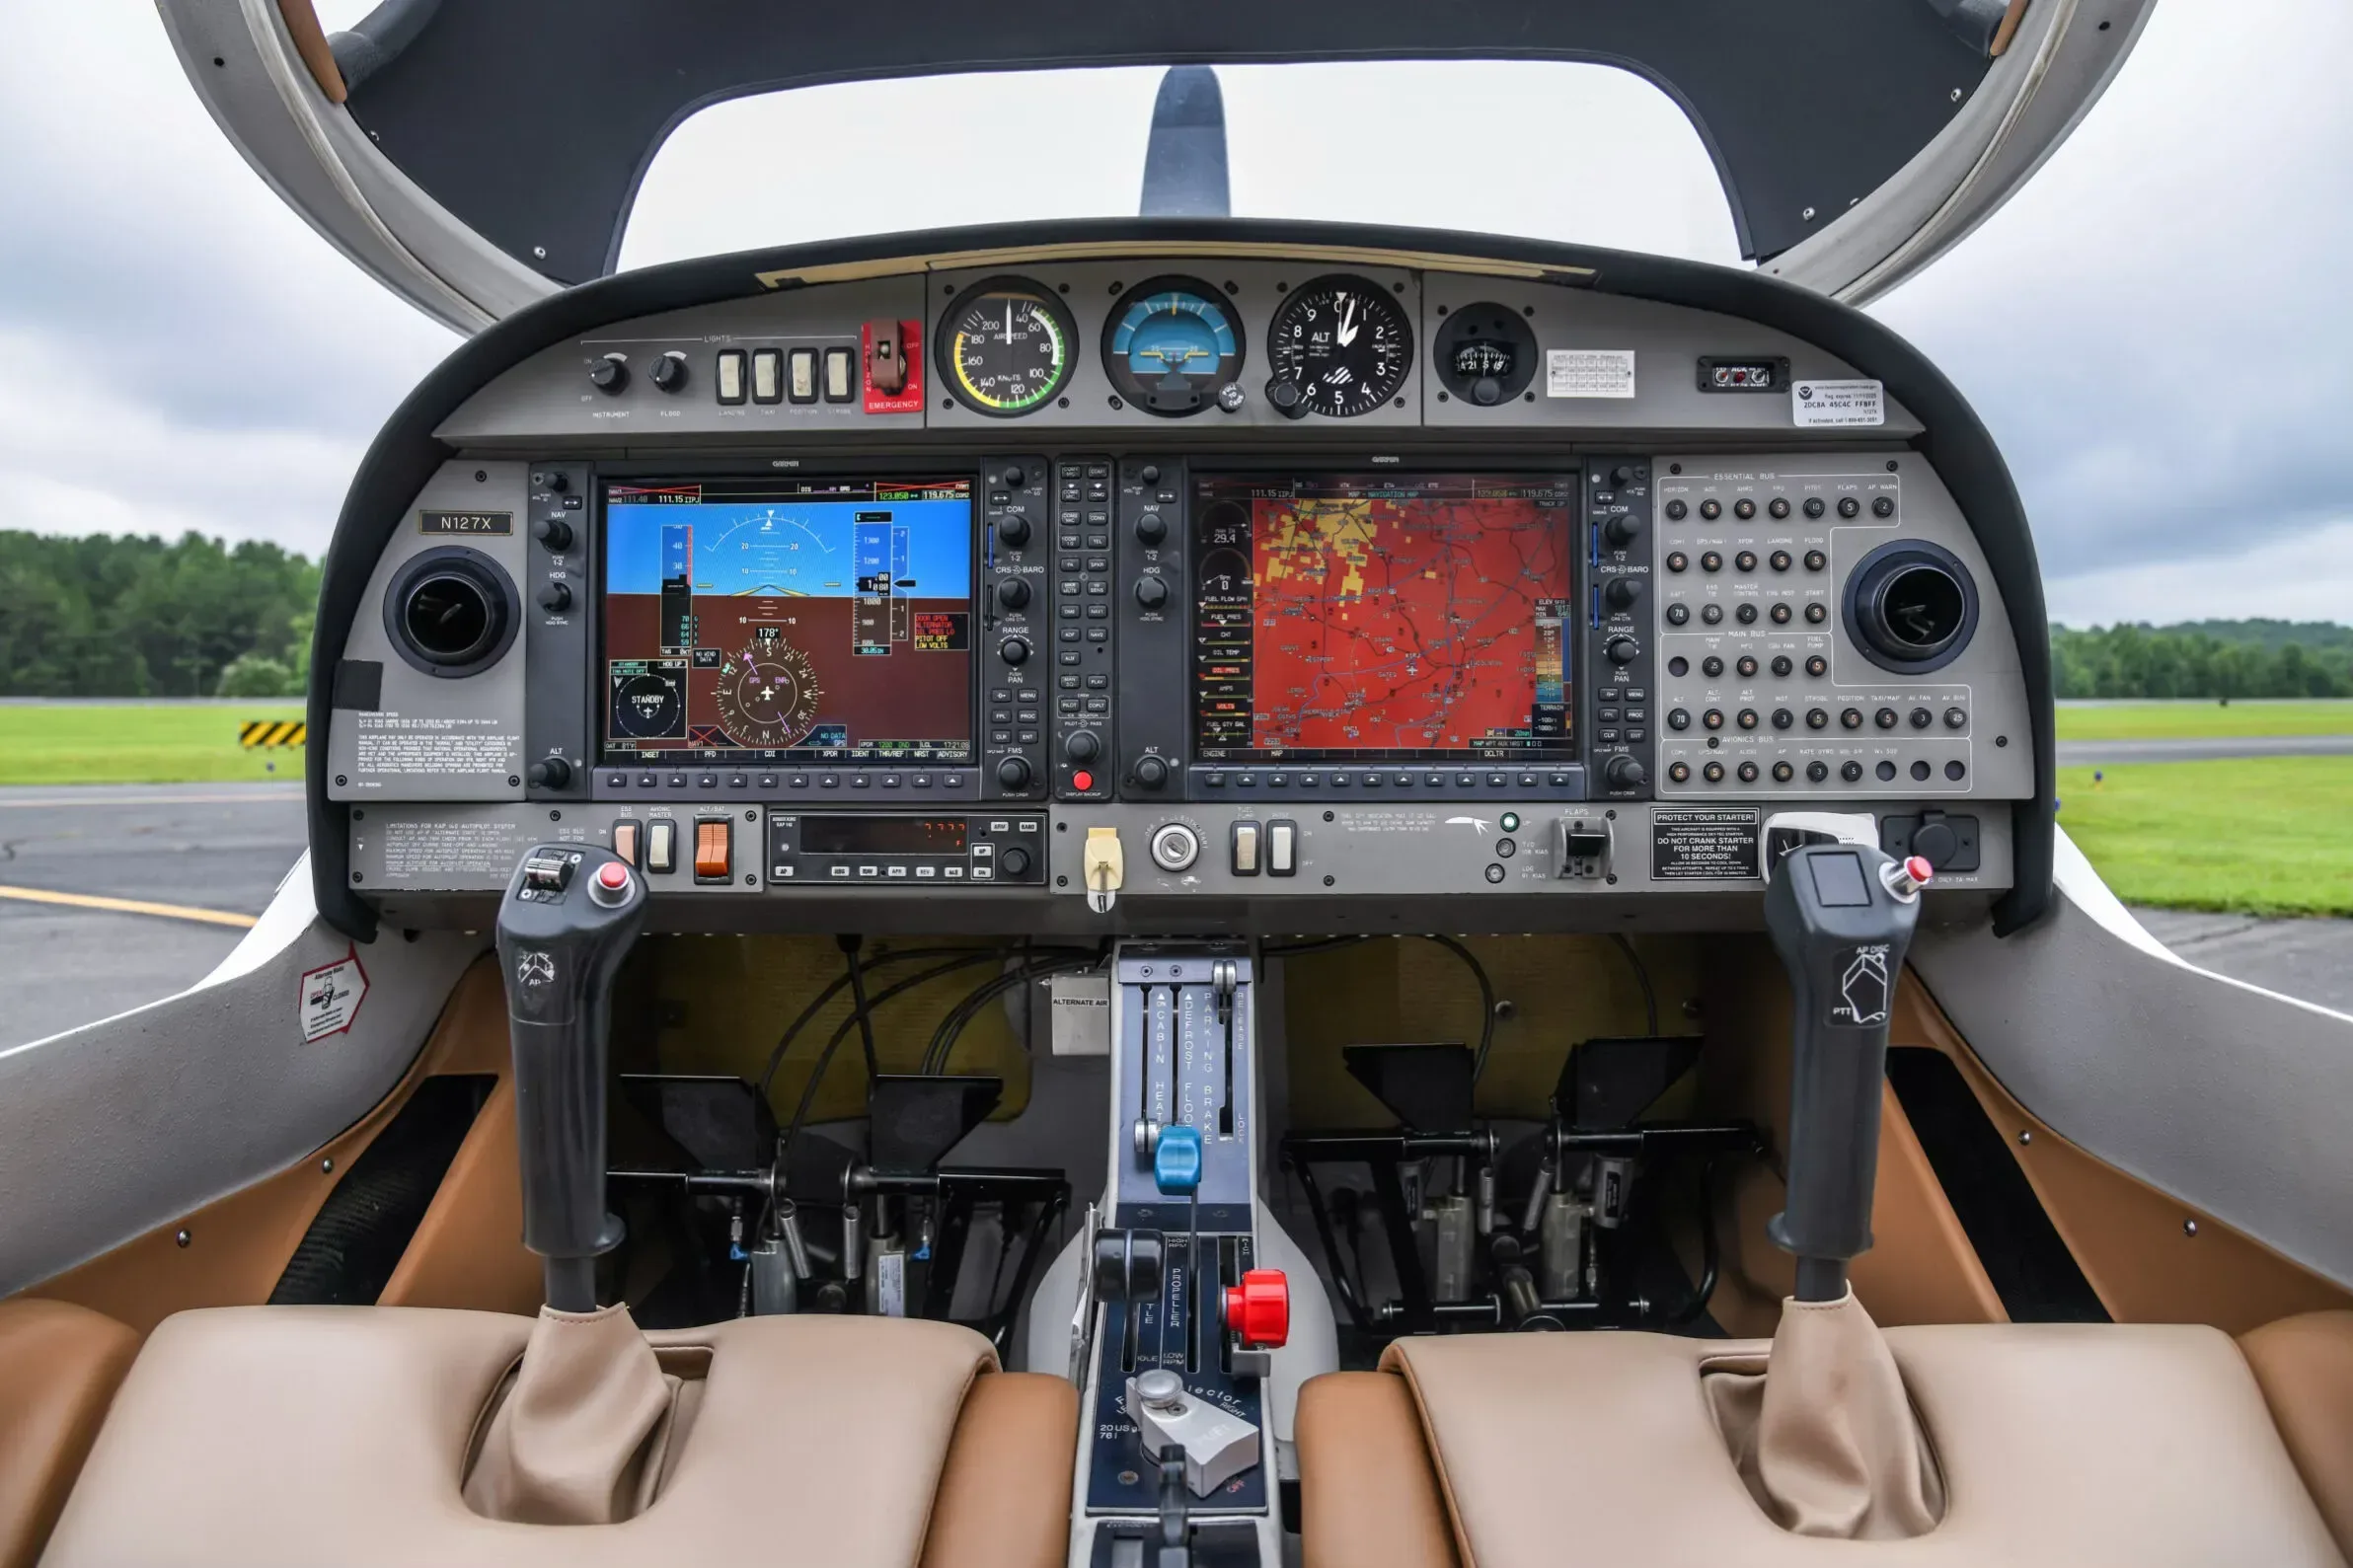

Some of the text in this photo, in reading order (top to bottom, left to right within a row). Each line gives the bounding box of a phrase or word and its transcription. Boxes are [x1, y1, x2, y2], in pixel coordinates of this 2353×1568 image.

[1016, 314, 1028, 323] 40
[1307, 309, 1316, 321] 9
[983, 321, 999, 330] 200
[1028, 323, 1041, 332] 60
[1294, 325, 1302, 337] 8
[1376, 326, 1384, 339] 2
[704, 335, 731, 343] LIGHTS
[971, 335, 984, 344] 180
[1311, 332, 1330, 342] ALT
[1040, 343, 1051, 352] 80
[968, 356, 983, 365] 160
[1030, 369, 1044, 378] 100
[1294, 367, 1302, 379] 7
[1376, 363, 1385, 375] 3
[981, 378, 995, 387] 140
[1011, 385, 1025, 394] 120
[1307, 383, 1316, 395] 6
[1361, 382, 1370, 395] 4
[1335, 391, 1343, 404] 5
[869, 400, 919, 409] EMERGENCY
[441, 517, 491, 529] N127X
[1214, 534, 1235, 543] 29.4
[759, 628, 778, 637] 178°
[767, 648, 772, 656] S
[803, 690, 812, 699] W
[1870, 944, 1890, 953] DISC
[1156, 1011, 1164, 1063] CABIN
[1185, 1001, 1193, 1070] DEFROST
[1204, 992, 1212, 1145] PARKING BRAKE
[1170, 1268, 1181, 1327] PROPELLER
[1188, 1385, 1242, 1405] lector
[1220, 1401, 1247, 1417] RIGHT
